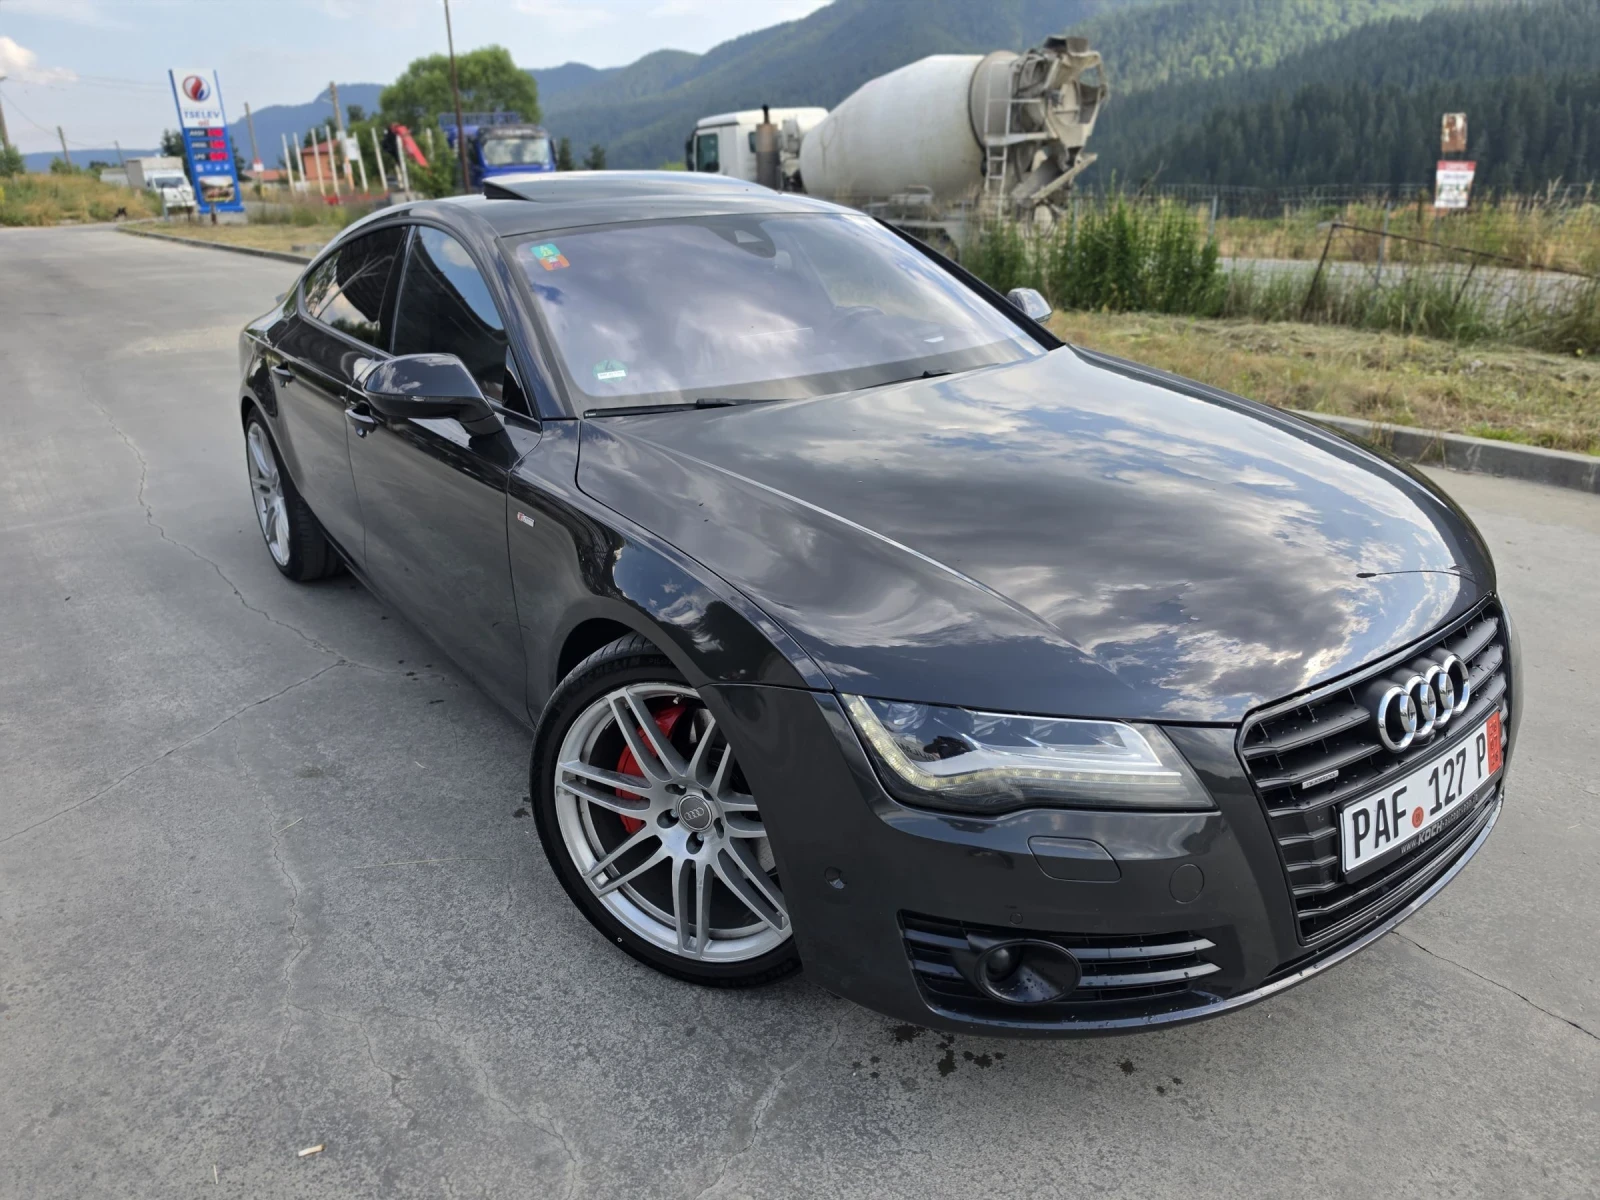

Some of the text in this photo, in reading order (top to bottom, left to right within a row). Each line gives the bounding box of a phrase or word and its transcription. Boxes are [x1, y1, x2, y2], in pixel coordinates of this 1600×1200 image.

[183, 110, 220, 119] TSELEV
[1352, 732, 1487, 859] PAF 127 P
